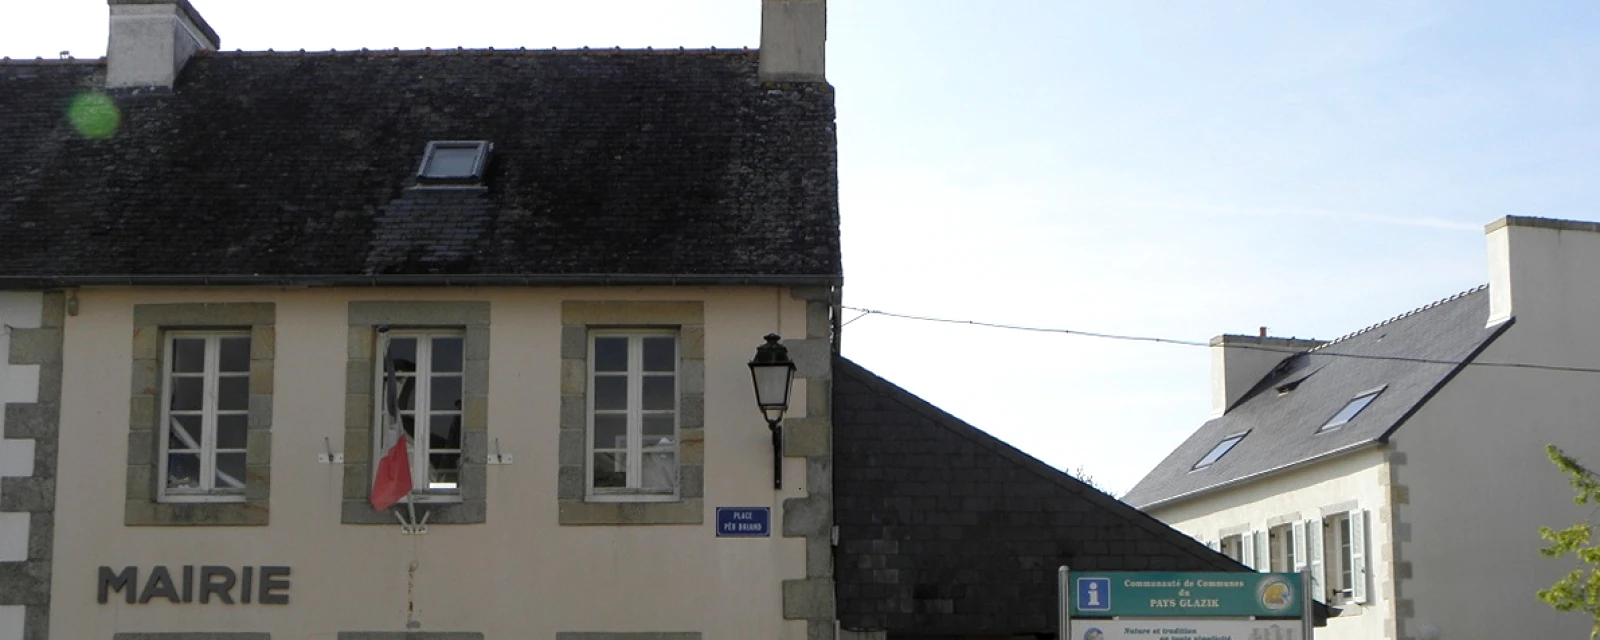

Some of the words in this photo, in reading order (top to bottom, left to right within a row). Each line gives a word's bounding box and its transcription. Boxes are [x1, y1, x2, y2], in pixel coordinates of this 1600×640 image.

[733, 511, 752, 520] PLACE
[739, 522, 762, 531] BRIAND
[98, 565, 291, 605] MAIRIE
[1124, 579, 1181, 587] Communauté
[1184, 579, 1194, 587] de
[1196, 579, 1244, 587] Communes
[1178, 588, 1190, 597] du
[1150, 599, 1176, 607] PAYS
[1179, 599, 1219, 607] GLAZIK
